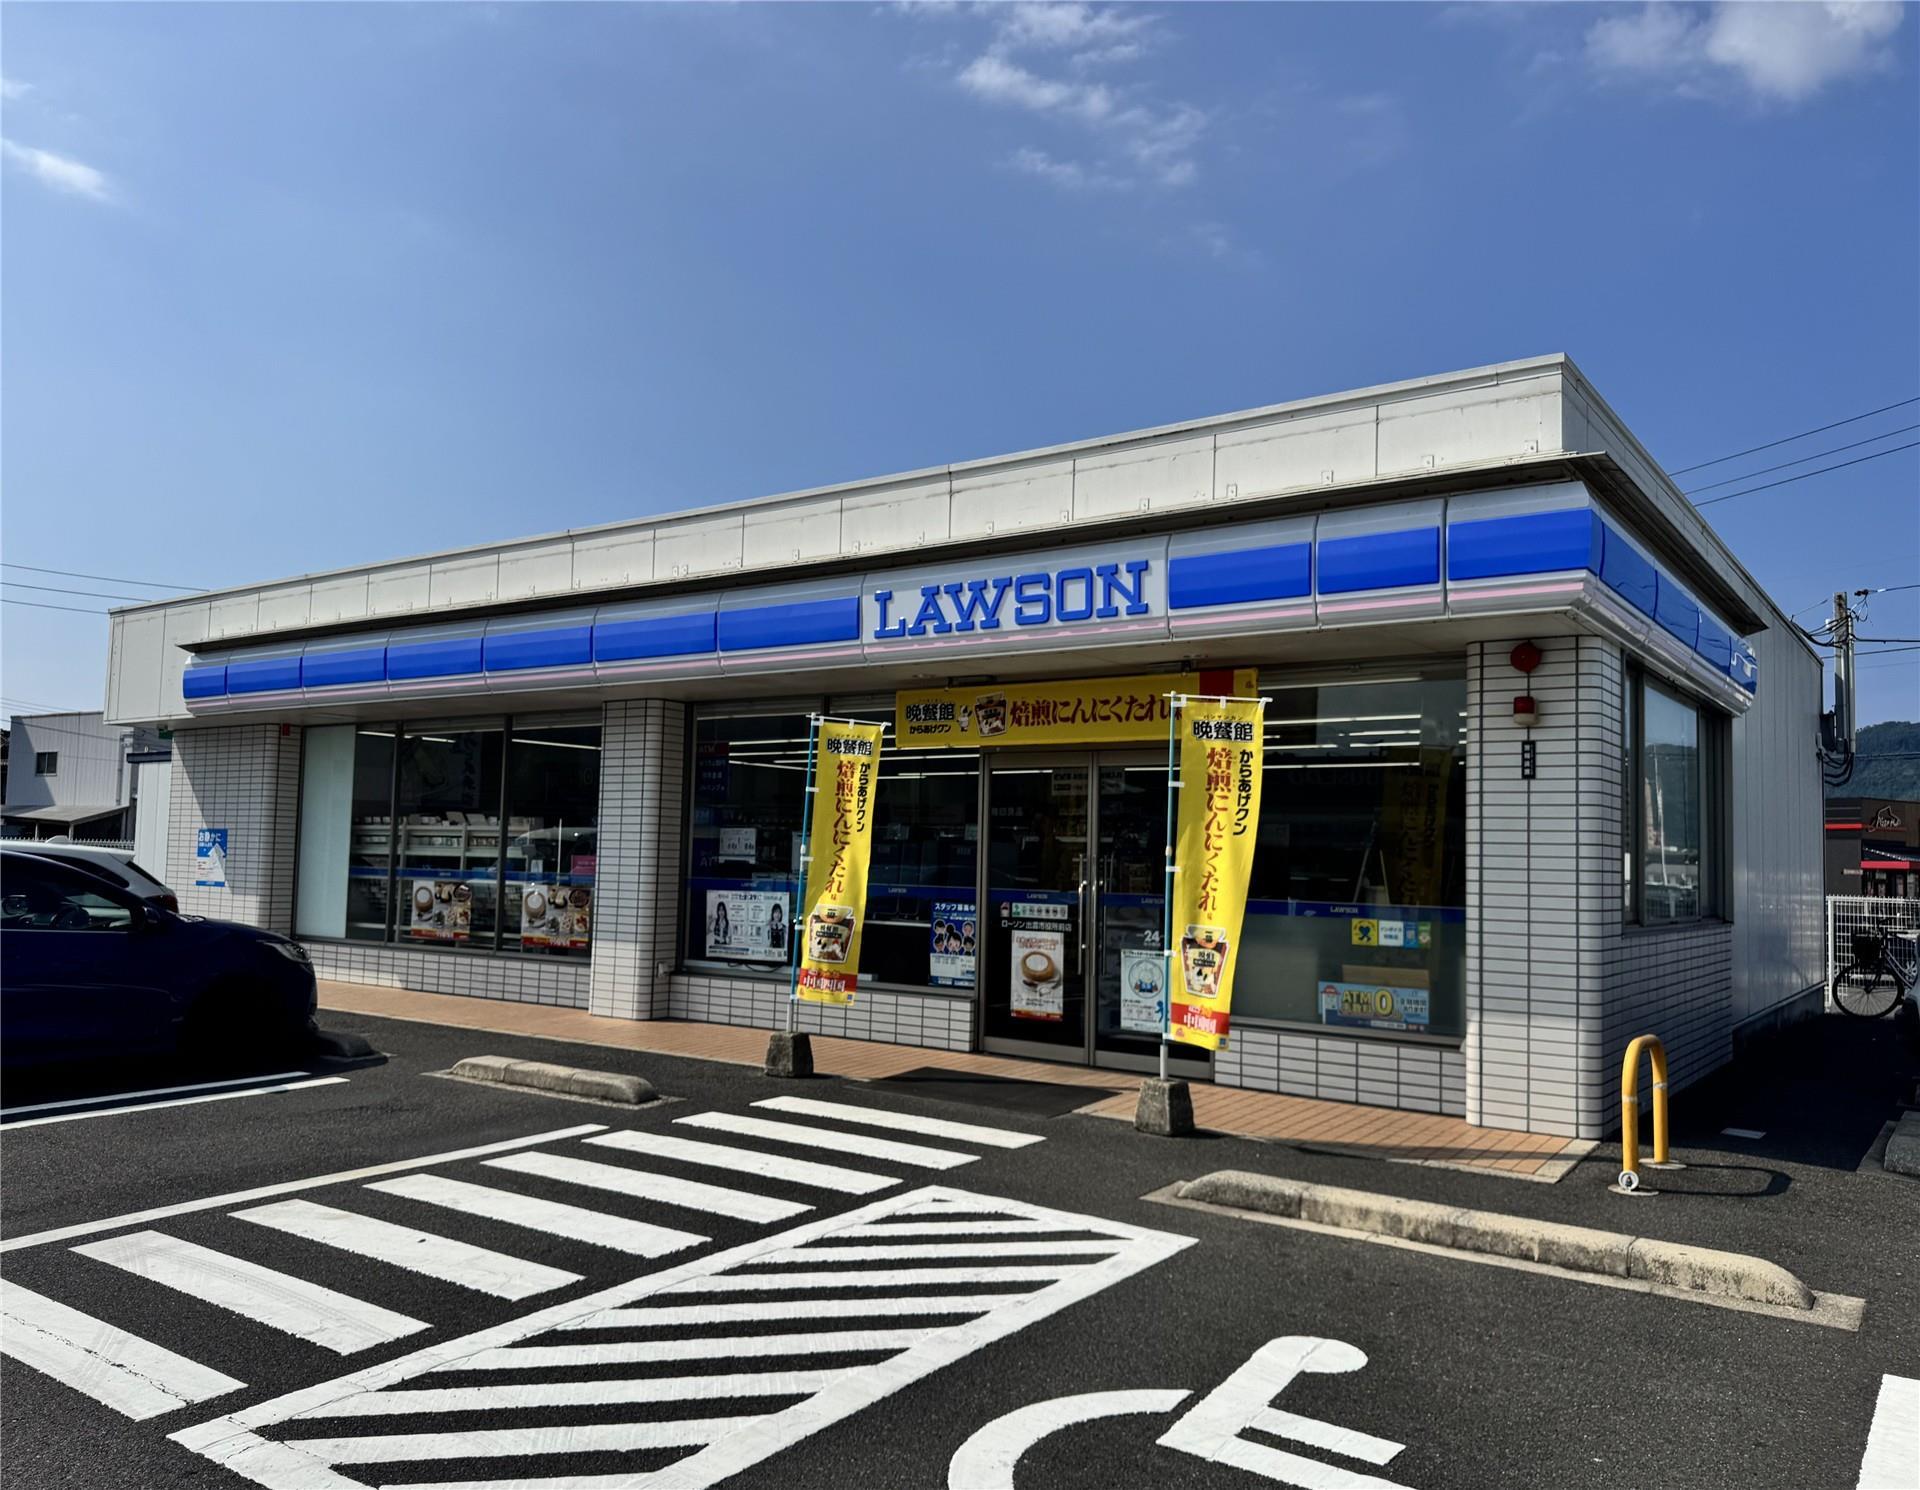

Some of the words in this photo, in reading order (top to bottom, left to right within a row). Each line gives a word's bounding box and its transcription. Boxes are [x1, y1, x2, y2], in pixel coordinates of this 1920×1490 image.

[874, 560, 1149, 639] LAWSON
[906, 703, 954, 722] 晩餐館
[910, 724, 952, 735] からあげクン
[1193, 720, 1253, 741] 晩餐館
[827, 738, 873, 756] 晩餐館
[856, 762, 871, 832] からあげクン
[1233, 748, 1253, 836] からあげクン
[1144, 929, 1160, 942] 24
